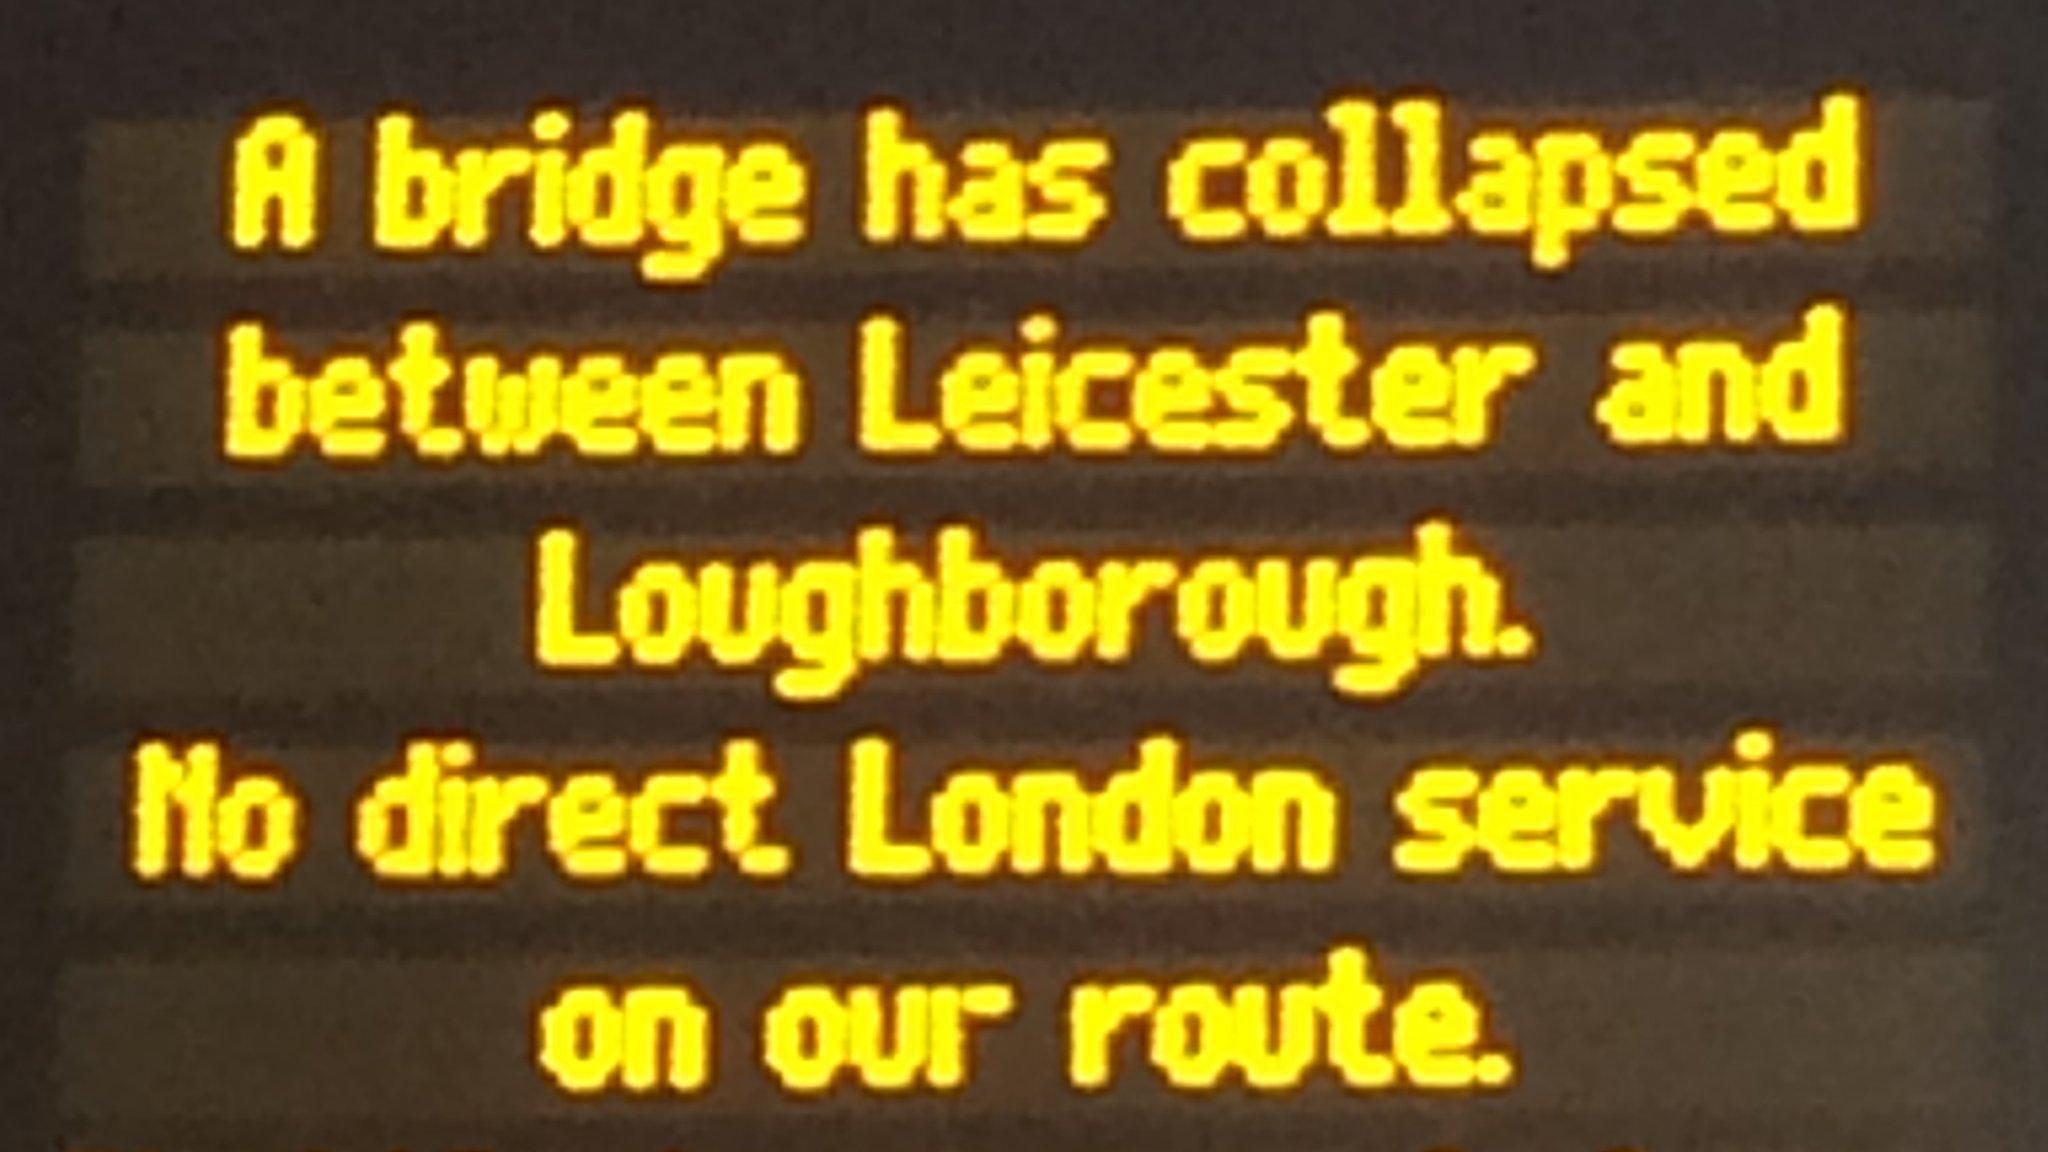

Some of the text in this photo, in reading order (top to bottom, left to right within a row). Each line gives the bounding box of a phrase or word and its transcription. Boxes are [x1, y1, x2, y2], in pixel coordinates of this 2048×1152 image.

[232, 93, 1864, 282] A bridge has collapsed
[224, 303, 1846, 459] between Leicester and
[535, 519, 1534, 701] Loughborough.
[133, 730, 1937, 879] No direct London service
[538, 945, 1514, 1092] on our route.
